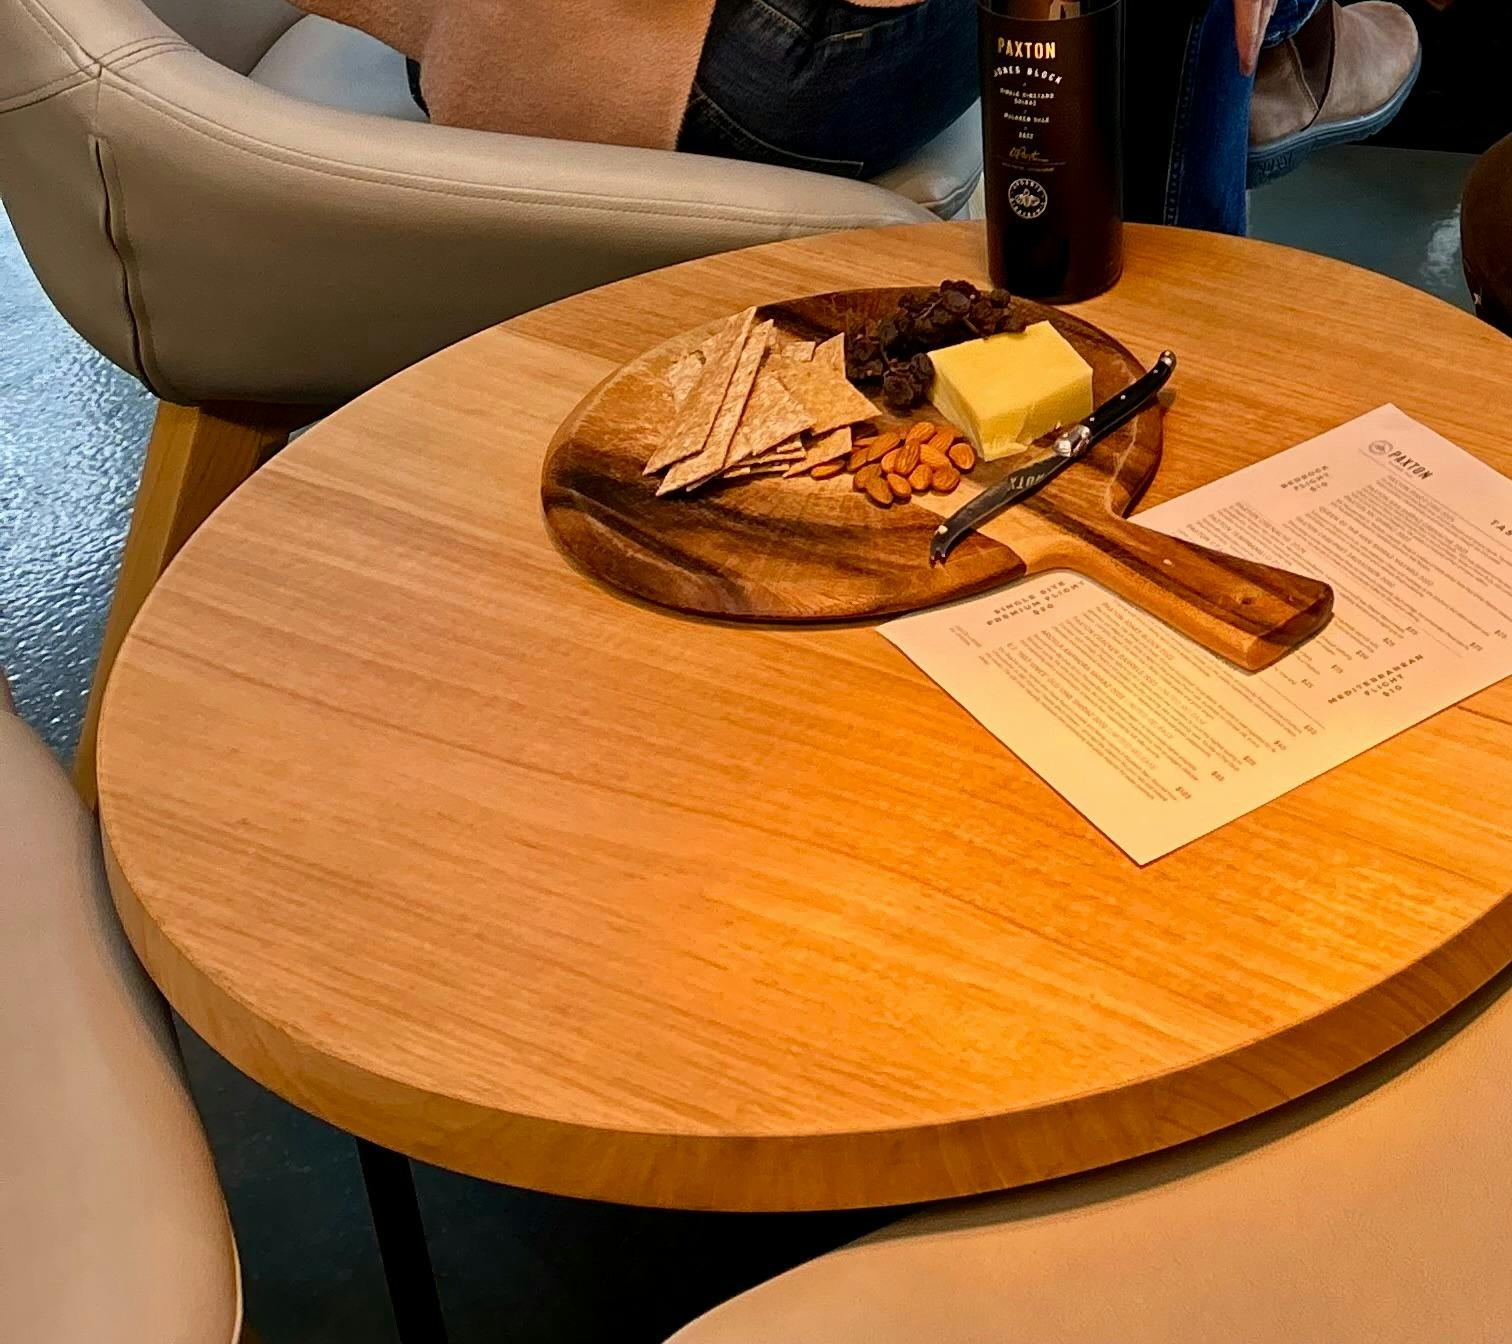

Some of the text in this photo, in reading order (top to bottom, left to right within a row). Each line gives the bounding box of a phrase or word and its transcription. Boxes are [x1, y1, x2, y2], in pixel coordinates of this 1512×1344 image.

[997, 36, 1056, 60] PAXTON
[1026, 67, 1063, 84] BLOCK
[1388, 450, 1433, 481] PAXTON
